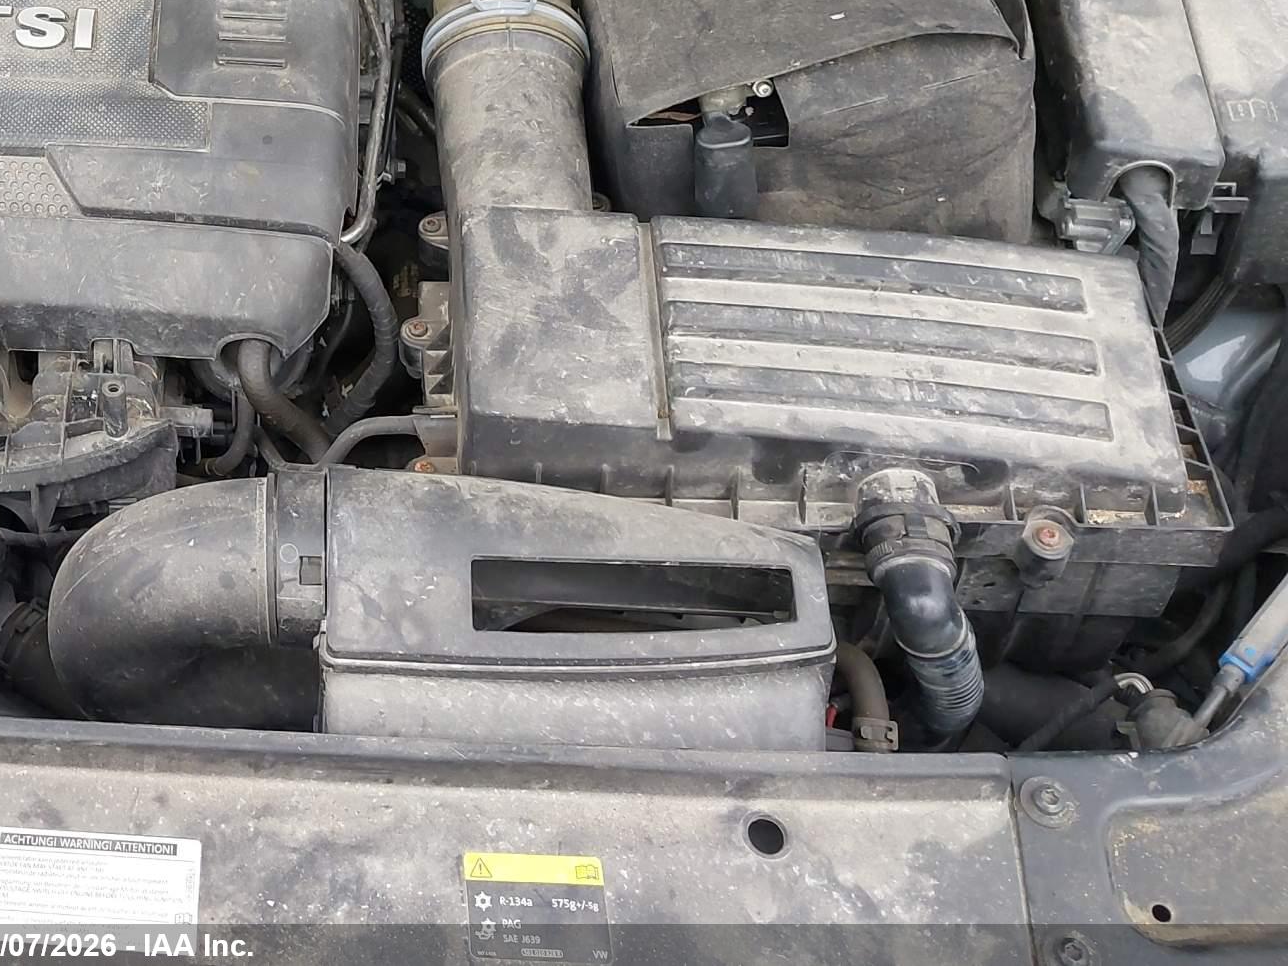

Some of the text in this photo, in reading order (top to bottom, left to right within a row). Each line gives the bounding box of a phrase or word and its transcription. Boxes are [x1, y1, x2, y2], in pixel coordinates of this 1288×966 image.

[3, 834, 175, 855] ACHTUNG! WARNING! ATTENTION!
[499, 896, 599, 913] R-134a 575g+/-5g
[502, 918, 522, 930] PAG
[502, 934, 541, 945] SAE J639
[592, 950, 608, 960] VW
